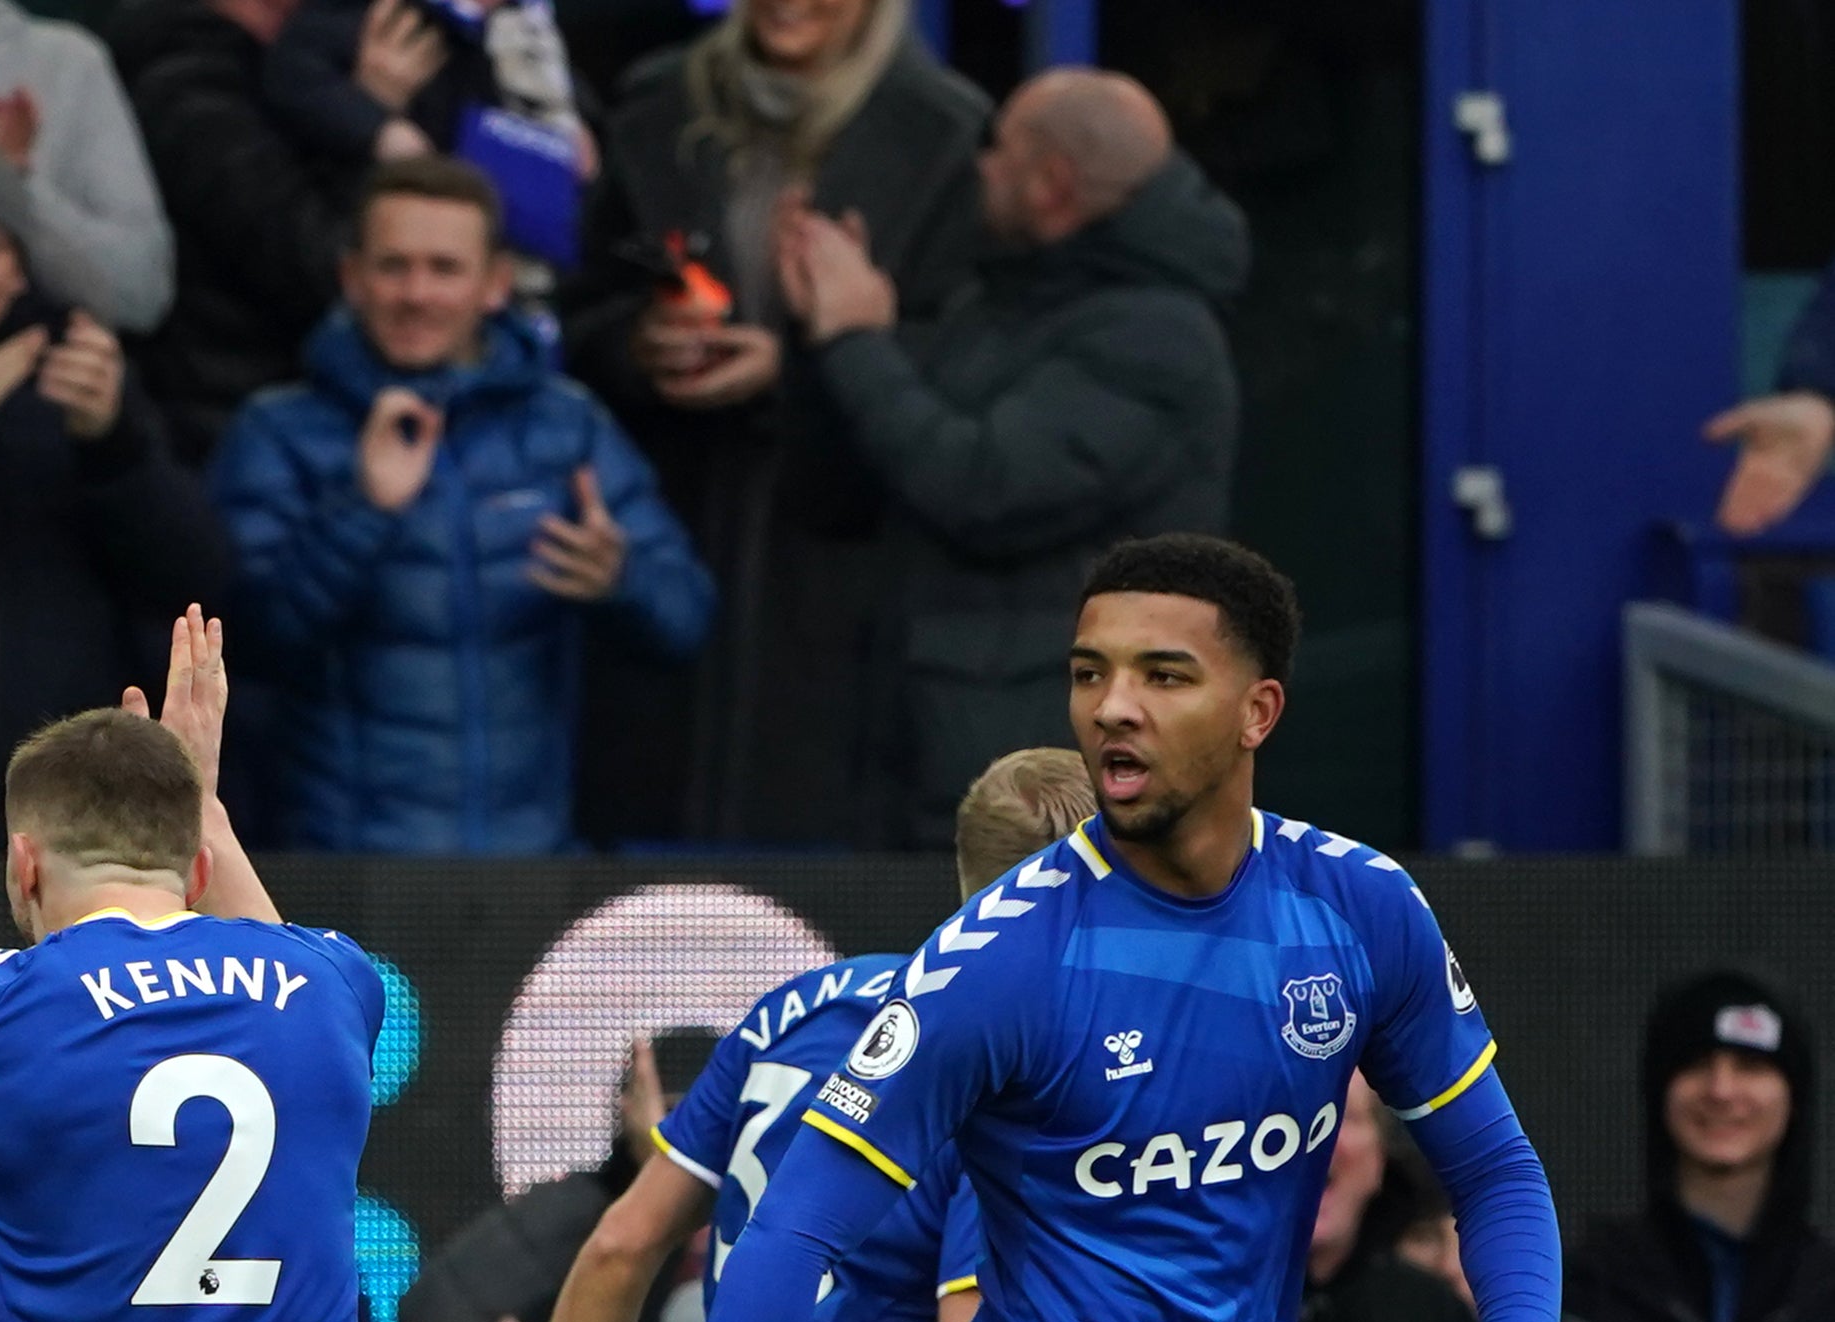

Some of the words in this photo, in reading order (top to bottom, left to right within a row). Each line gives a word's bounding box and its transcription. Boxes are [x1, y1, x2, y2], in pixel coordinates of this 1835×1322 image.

[80, 957, 308, 1020] KENNY
[739, 967, 854, 1051] VAN
[854, 969, 897, 1004] D
[1301, 1020, 1341, 1035] Everton
[1105, 1057, 1154, 1081] hummel
[834, 1080, 873, 1109] room
[128, 1052, 283, 1306] 2
